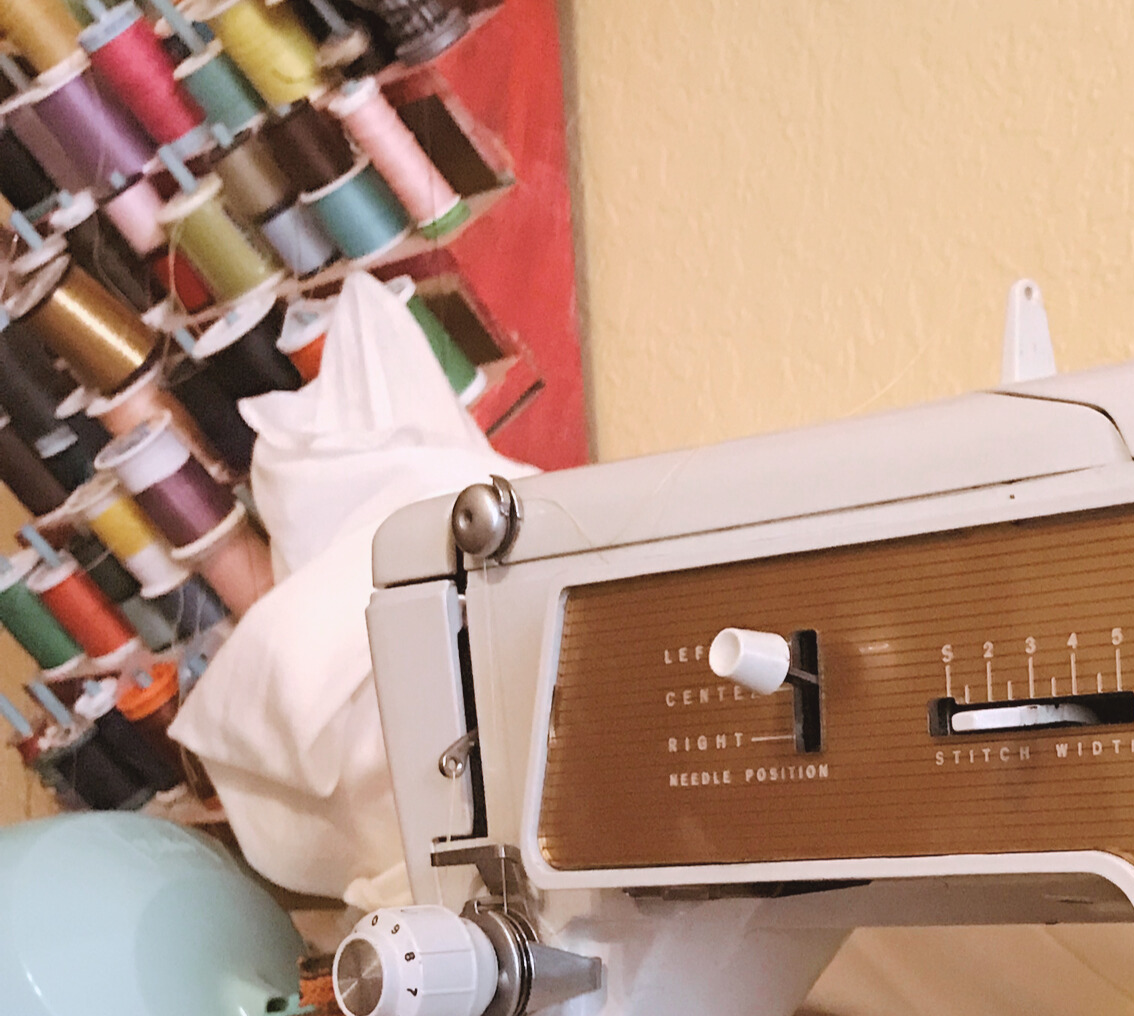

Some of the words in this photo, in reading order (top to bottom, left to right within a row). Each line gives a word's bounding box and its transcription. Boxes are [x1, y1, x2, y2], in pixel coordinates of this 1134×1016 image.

[983, 641, 994, 658] 2
[1025, 636, 1036, 654] 3
[1067, 632, 1078, 649] 4
[1111, 627, 1123, 645] 5
[664, 645, 704, 665] LEF
[666, 685, 760, 707] CENTE
[668, 732, 744, 752] RIGHT
[935, 746, 1030, 766] STITCH
[669, 770, 731, 787] NEEDLE
[745, 764, 829, 782] POSITION
[404, 951, 416, 962] 8
[407, 987, 418, 997] 7
